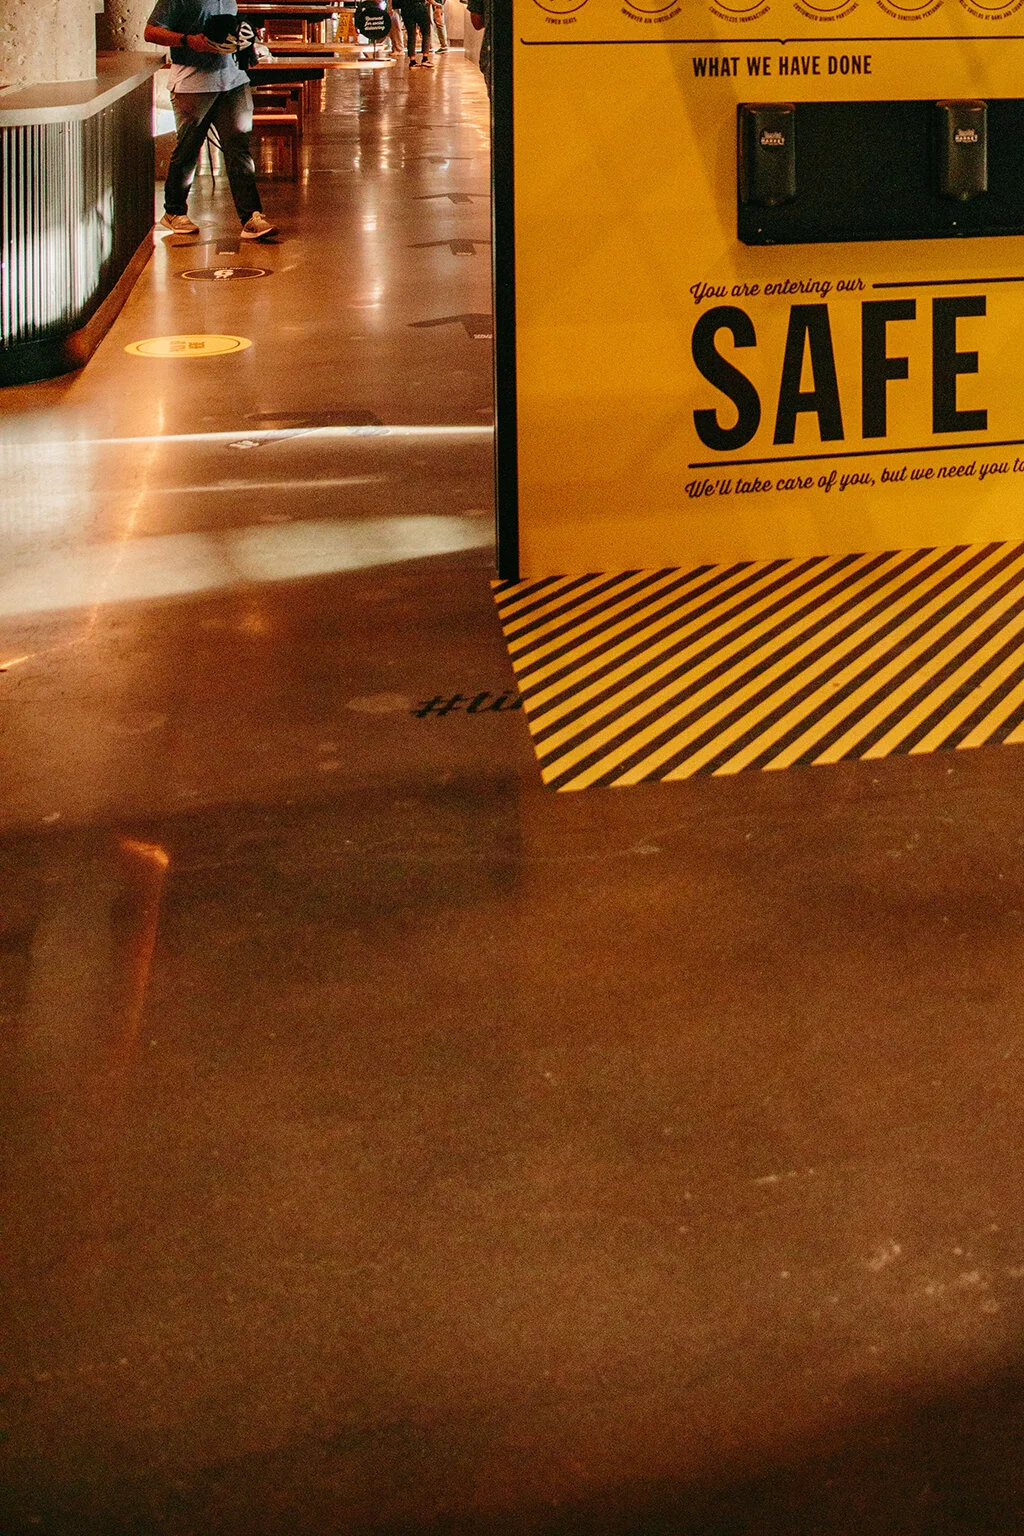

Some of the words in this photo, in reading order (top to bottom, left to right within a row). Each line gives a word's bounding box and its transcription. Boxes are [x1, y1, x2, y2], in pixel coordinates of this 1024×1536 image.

[692, 57, 740, 77] WHAT
[746, 56, 772, 76] WE
[779, 56, 821, 76] HAVE
[828, 55, 872, 75] DONE
[690, 282, 728, 304] You
[731, 284, 760, 296] are
[766, 278, 833, 298] entering
[836, 278, 866, 292] our
[691, 295, 988, 452] SAFE
[684, 480, 732, 498] We'll
[734, 476, 772, 494] take
[776, 476, 814, 491] care
[818, 470, 841, 492] of
[840, 472, 876, 492] you,
[880, 466, 908, 482] but
[910, 468, 934, 480] we
[936, 462, 977, 479] need
[978, 462, 1010, 480] you
